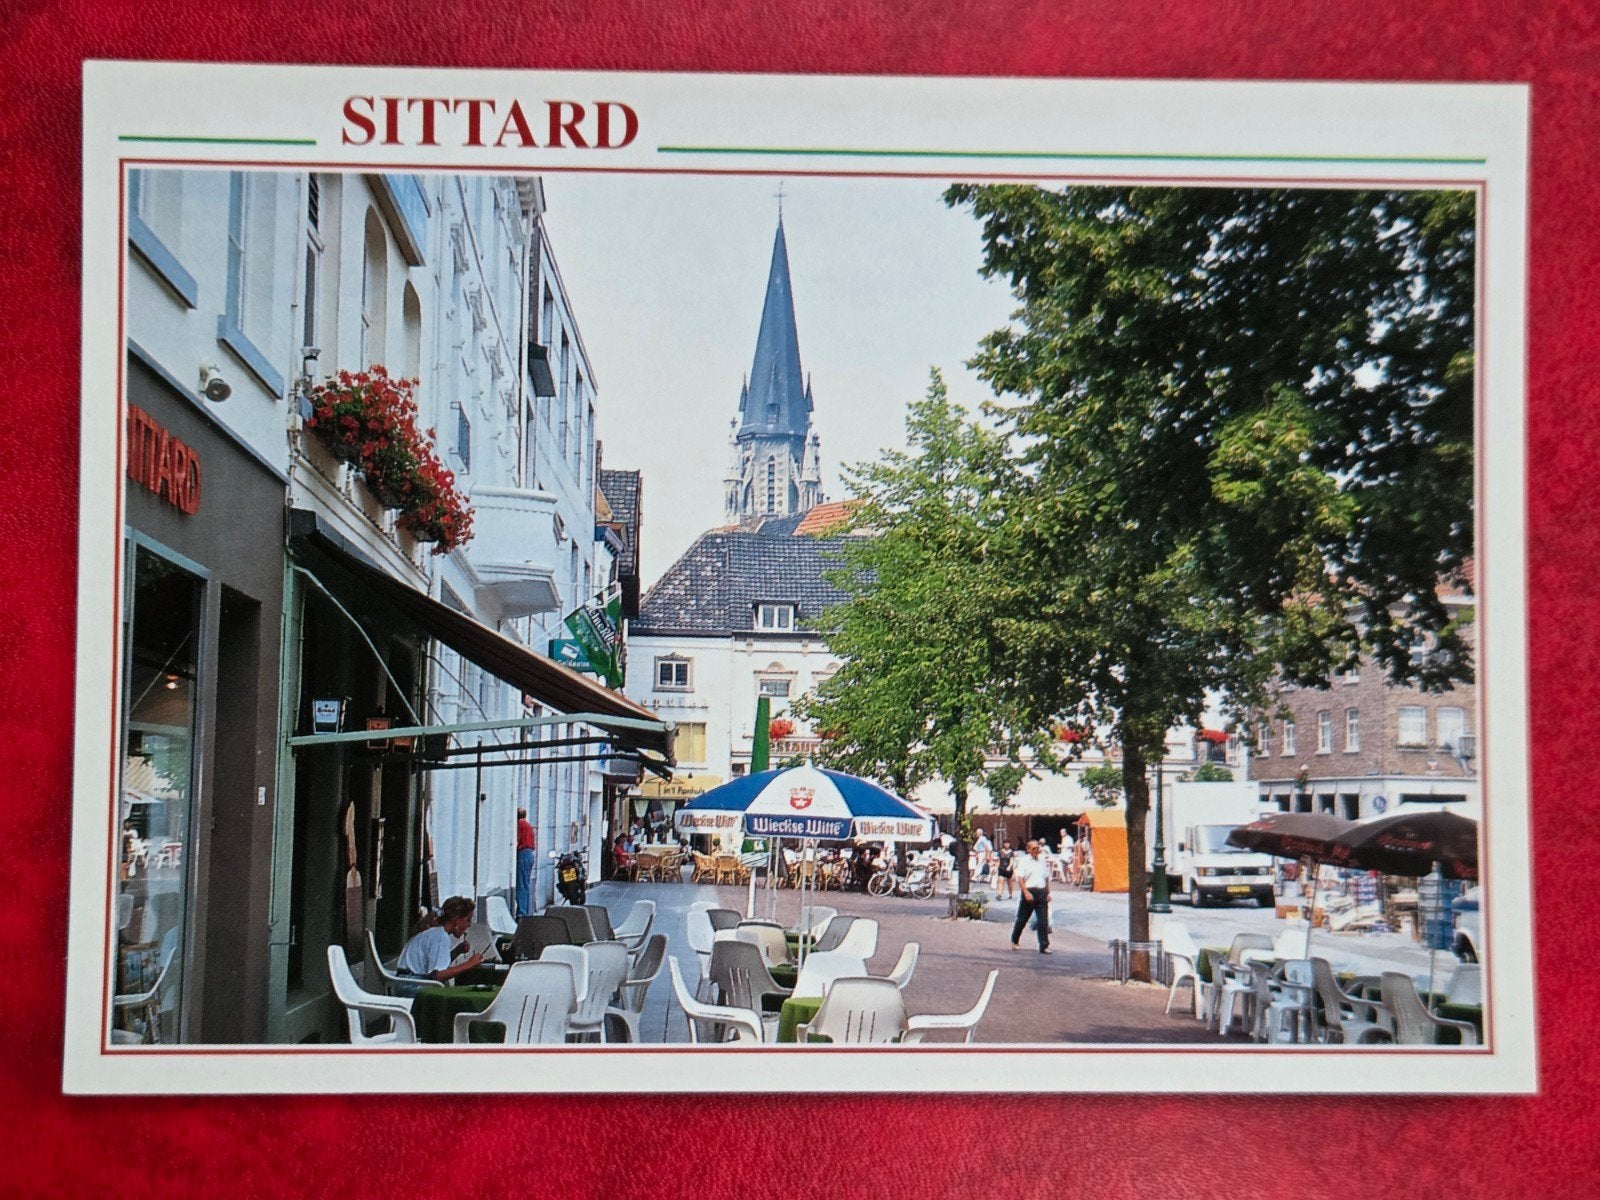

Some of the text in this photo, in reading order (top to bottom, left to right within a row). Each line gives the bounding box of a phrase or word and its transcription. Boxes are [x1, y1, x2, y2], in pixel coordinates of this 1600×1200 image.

[127, 404, 202, 516] ITTARD
[753, 817, 842, 835] Wieckse Witte
